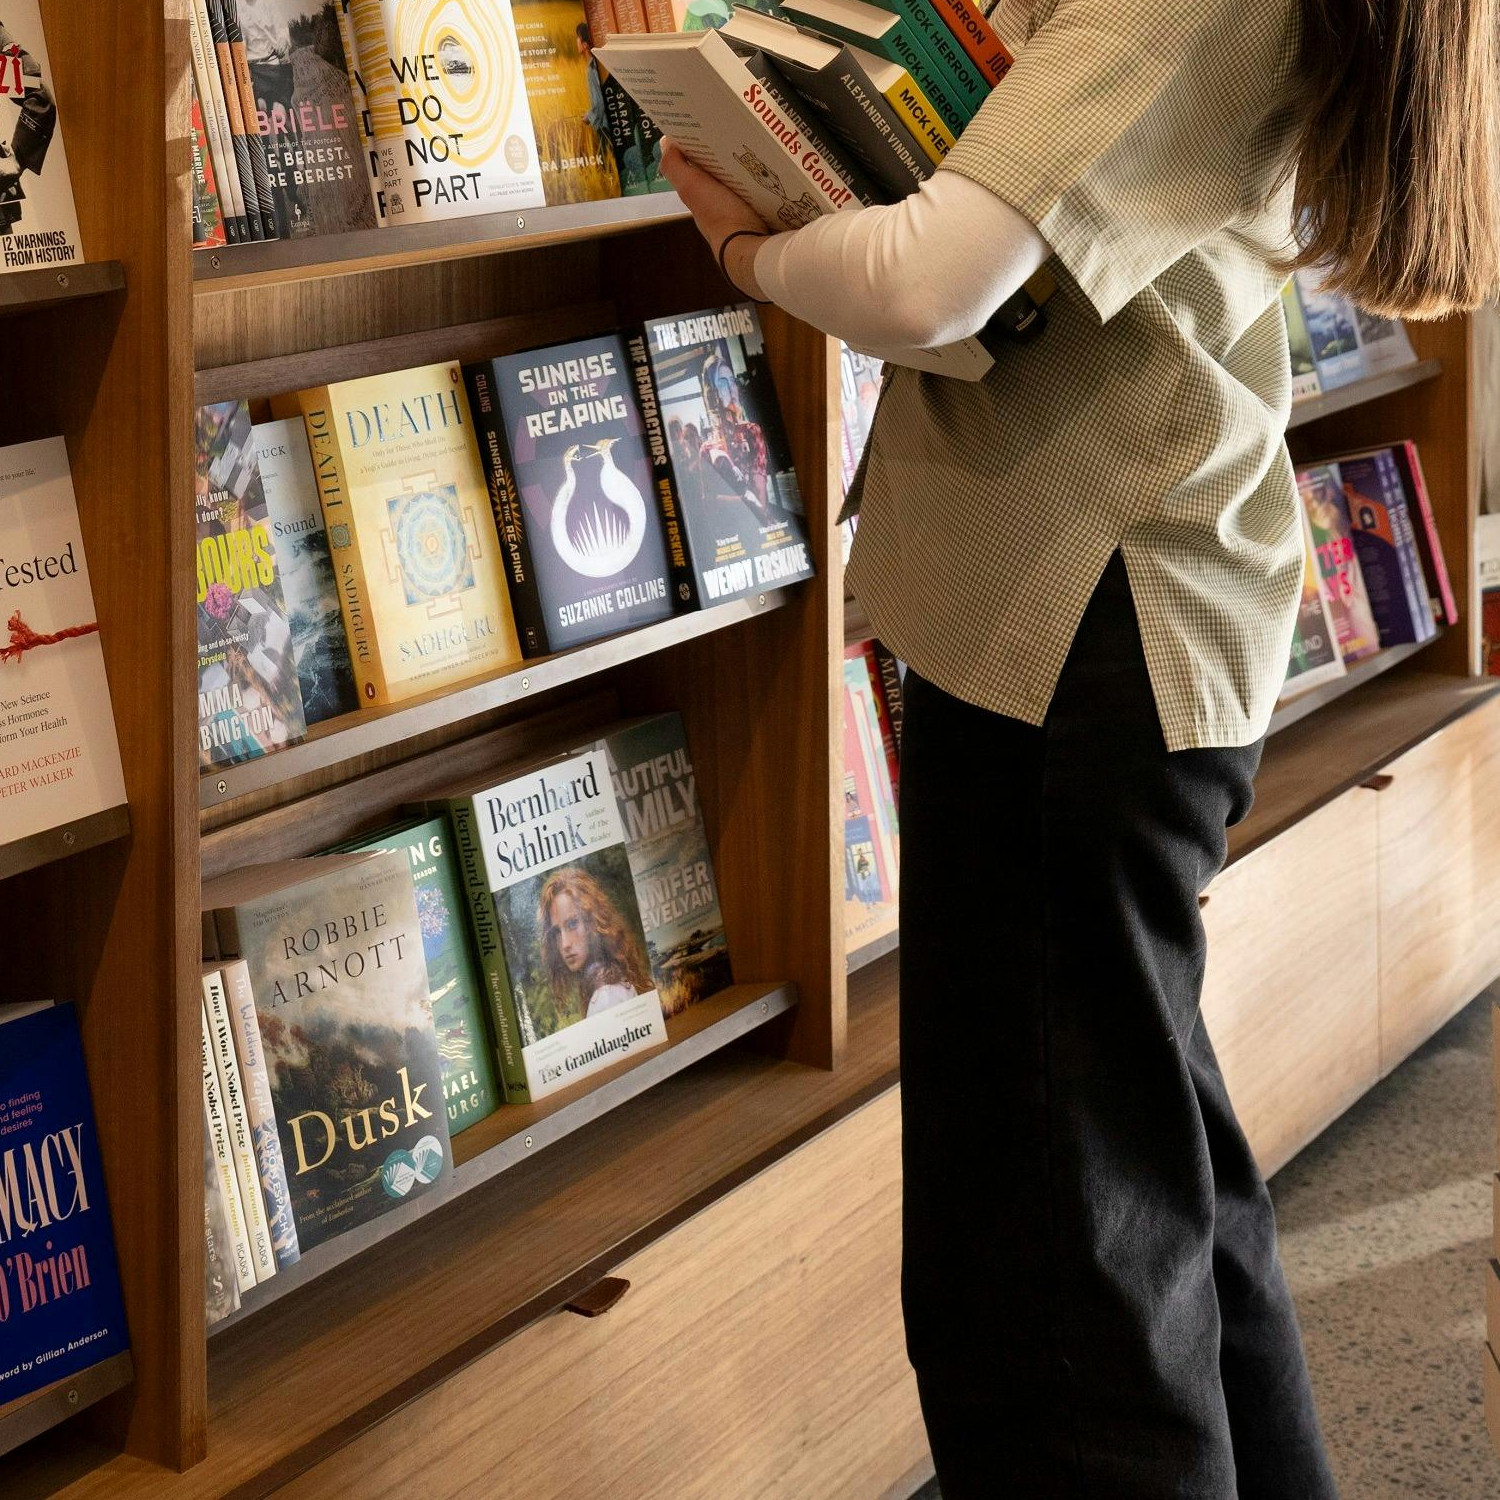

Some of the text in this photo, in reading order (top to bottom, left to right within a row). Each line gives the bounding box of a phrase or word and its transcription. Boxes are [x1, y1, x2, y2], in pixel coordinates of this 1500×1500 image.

[390, 54, 436, 81] WE
[398, 95, 443, 125] DO
[838, 72, 927, 179] ALEXANDER VINDMAN
[406, 134, 463, 168] NOT
[742, 83, 850, 212] Sounds Good!
[414, 173, 482, 206] PART
[653, 309, 754, 351] THE BENEFACTORS
[518, 351, 617, 393] SUNRISE
[548, 382, 599, 405] ON THE
[345, 390, 464, 449] DEATH
[526, 396, 628, 439] REAPING
[703, 544, 811, 599] WENDY ERSKINE
[558, 577, 667, 628] SUZANNE COLLINS
[485, 761, 601, 836] Bernhard
[495, 815, 588, 879] Schlink
[281, 904, 389, 961] ROBBIE
[269, 933, 408, 1008] ARNOTT
[563, 1020, 654, 1079] Granddaughter
[287, 1068, 433, 1175] Dusk
[36, 1328, 109, 1364] Gillian Anderson
